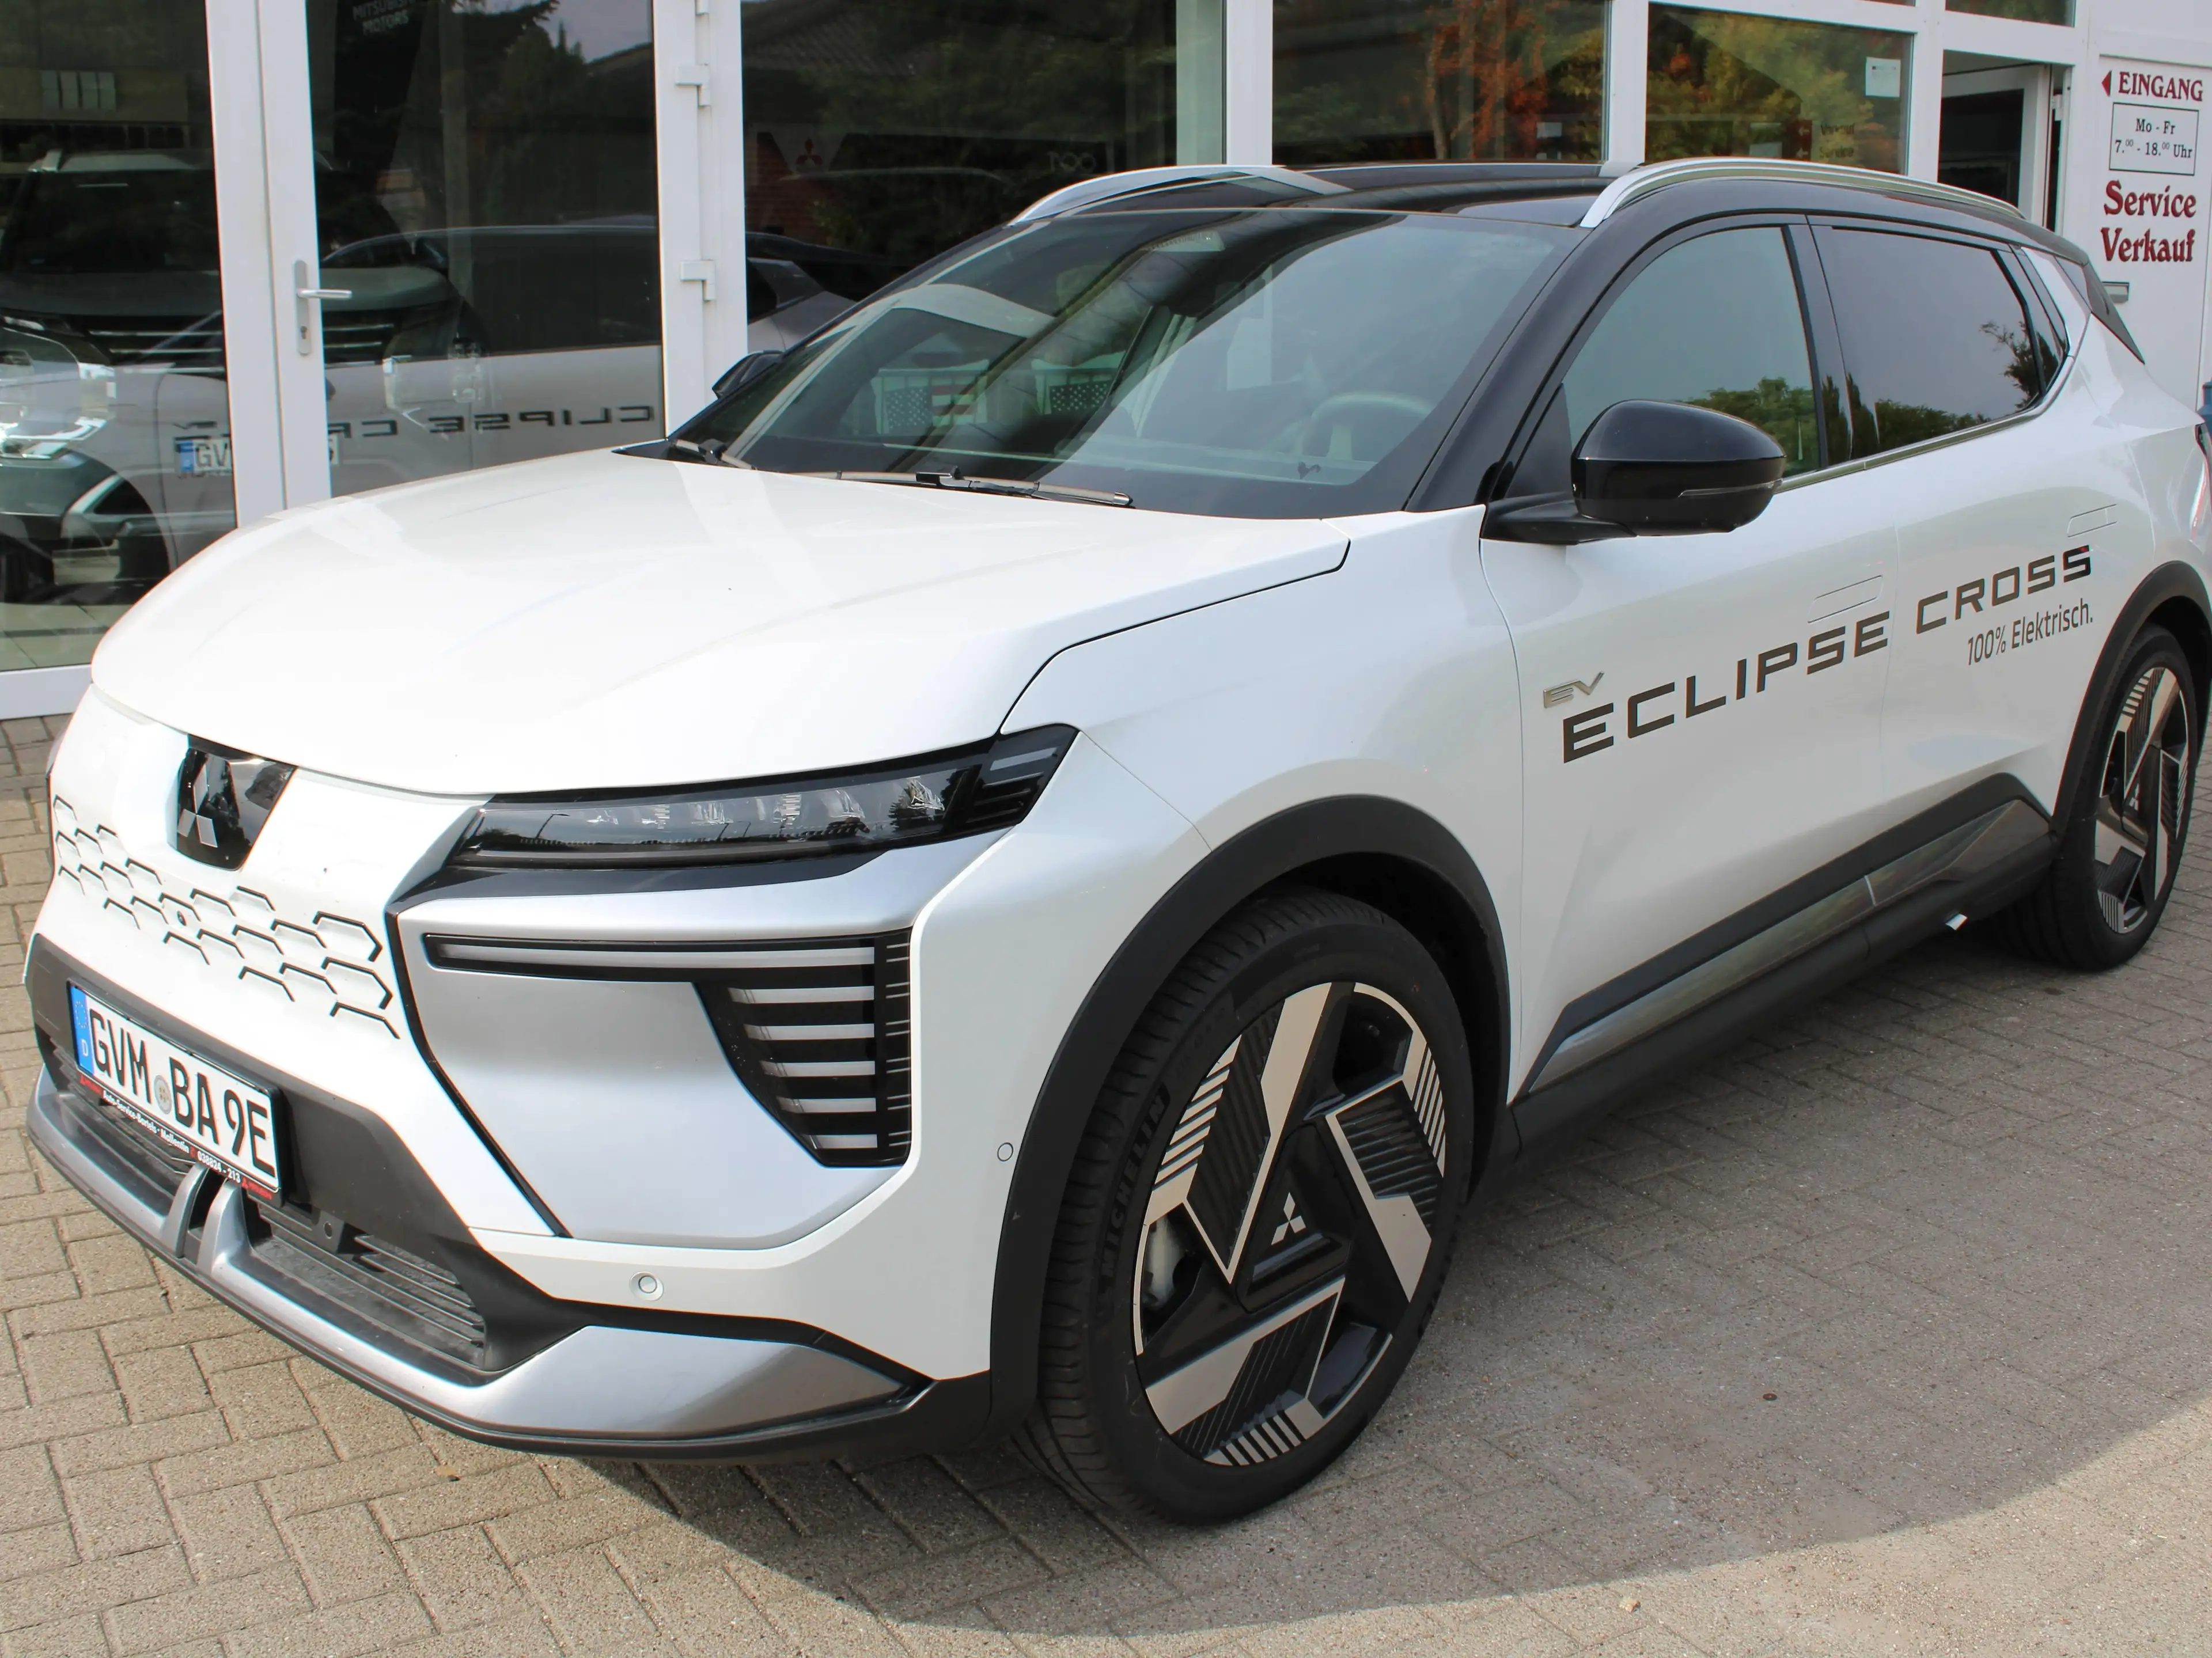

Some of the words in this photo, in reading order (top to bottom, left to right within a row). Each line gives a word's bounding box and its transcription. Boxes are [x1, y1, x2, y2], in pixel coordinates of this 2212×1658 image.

[352, 0, 416, 21] MITSUBIS
[2118, 71, 2203, 101] EINGANG
[2135, 118, 2152, 133] Mo
[2163, 120, 2175, 135] Fr
[2173, 144, 2192, 158] Uhr
[2103, 180, 2196, 218] Service
[2100, 227, 2196, 262] Verkauf
[1967, 625, 2006, 666] 100%
[2011, 598, 2093, 650] Elektrisch.
[1563, 610, 1890, 764] ECLIPSE
[1915, 544, 2091, 635] CROSS
[1543, 671, 1604, 709] EV
[81, 1038, 89, 1057] D
[89, 1008, 151, 1104] GVM
[1101, 1096, 1166, 1276] MICHELIN
